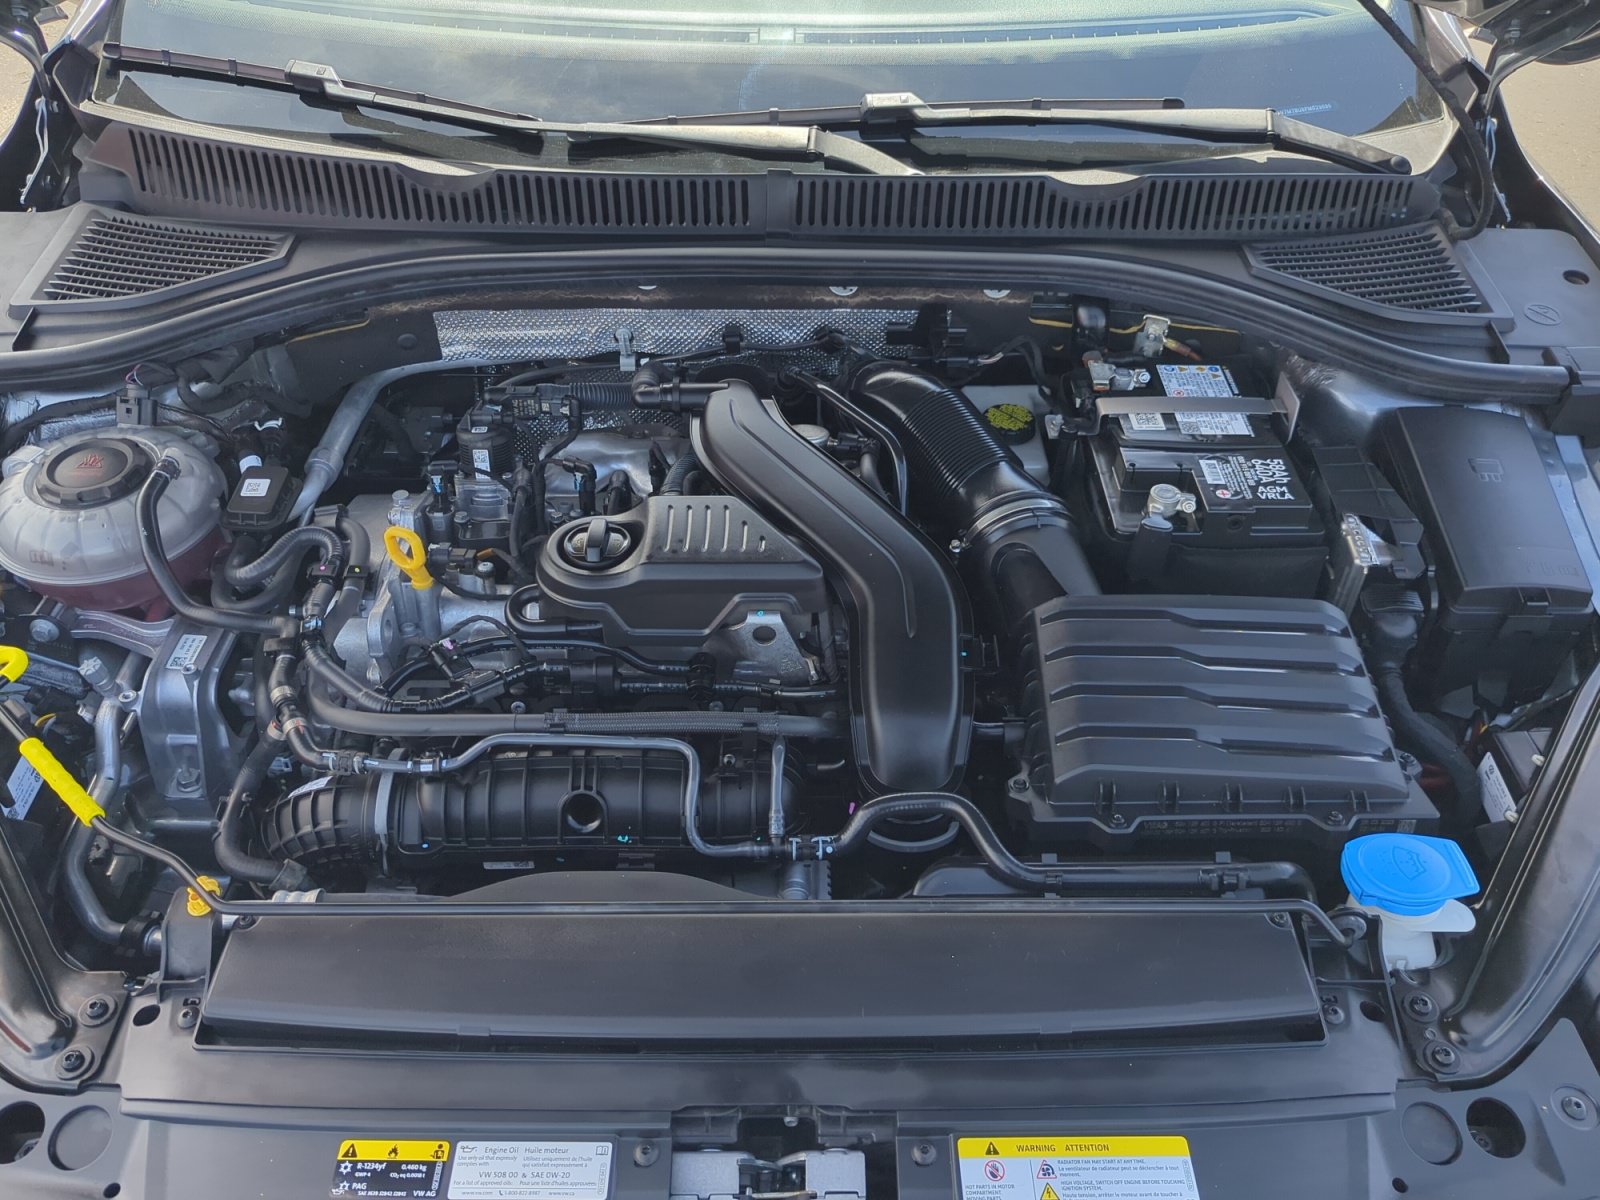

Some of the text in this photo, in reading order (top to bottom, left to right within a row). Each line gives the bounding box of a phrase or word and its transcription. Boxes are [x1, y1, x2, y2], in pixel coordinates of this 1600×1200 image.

[1251, 459, 1275, 484] 640A
[1267, 459, 1291, 484] 58Ah
[356, 1163, 387, 1172] R-1234yf
